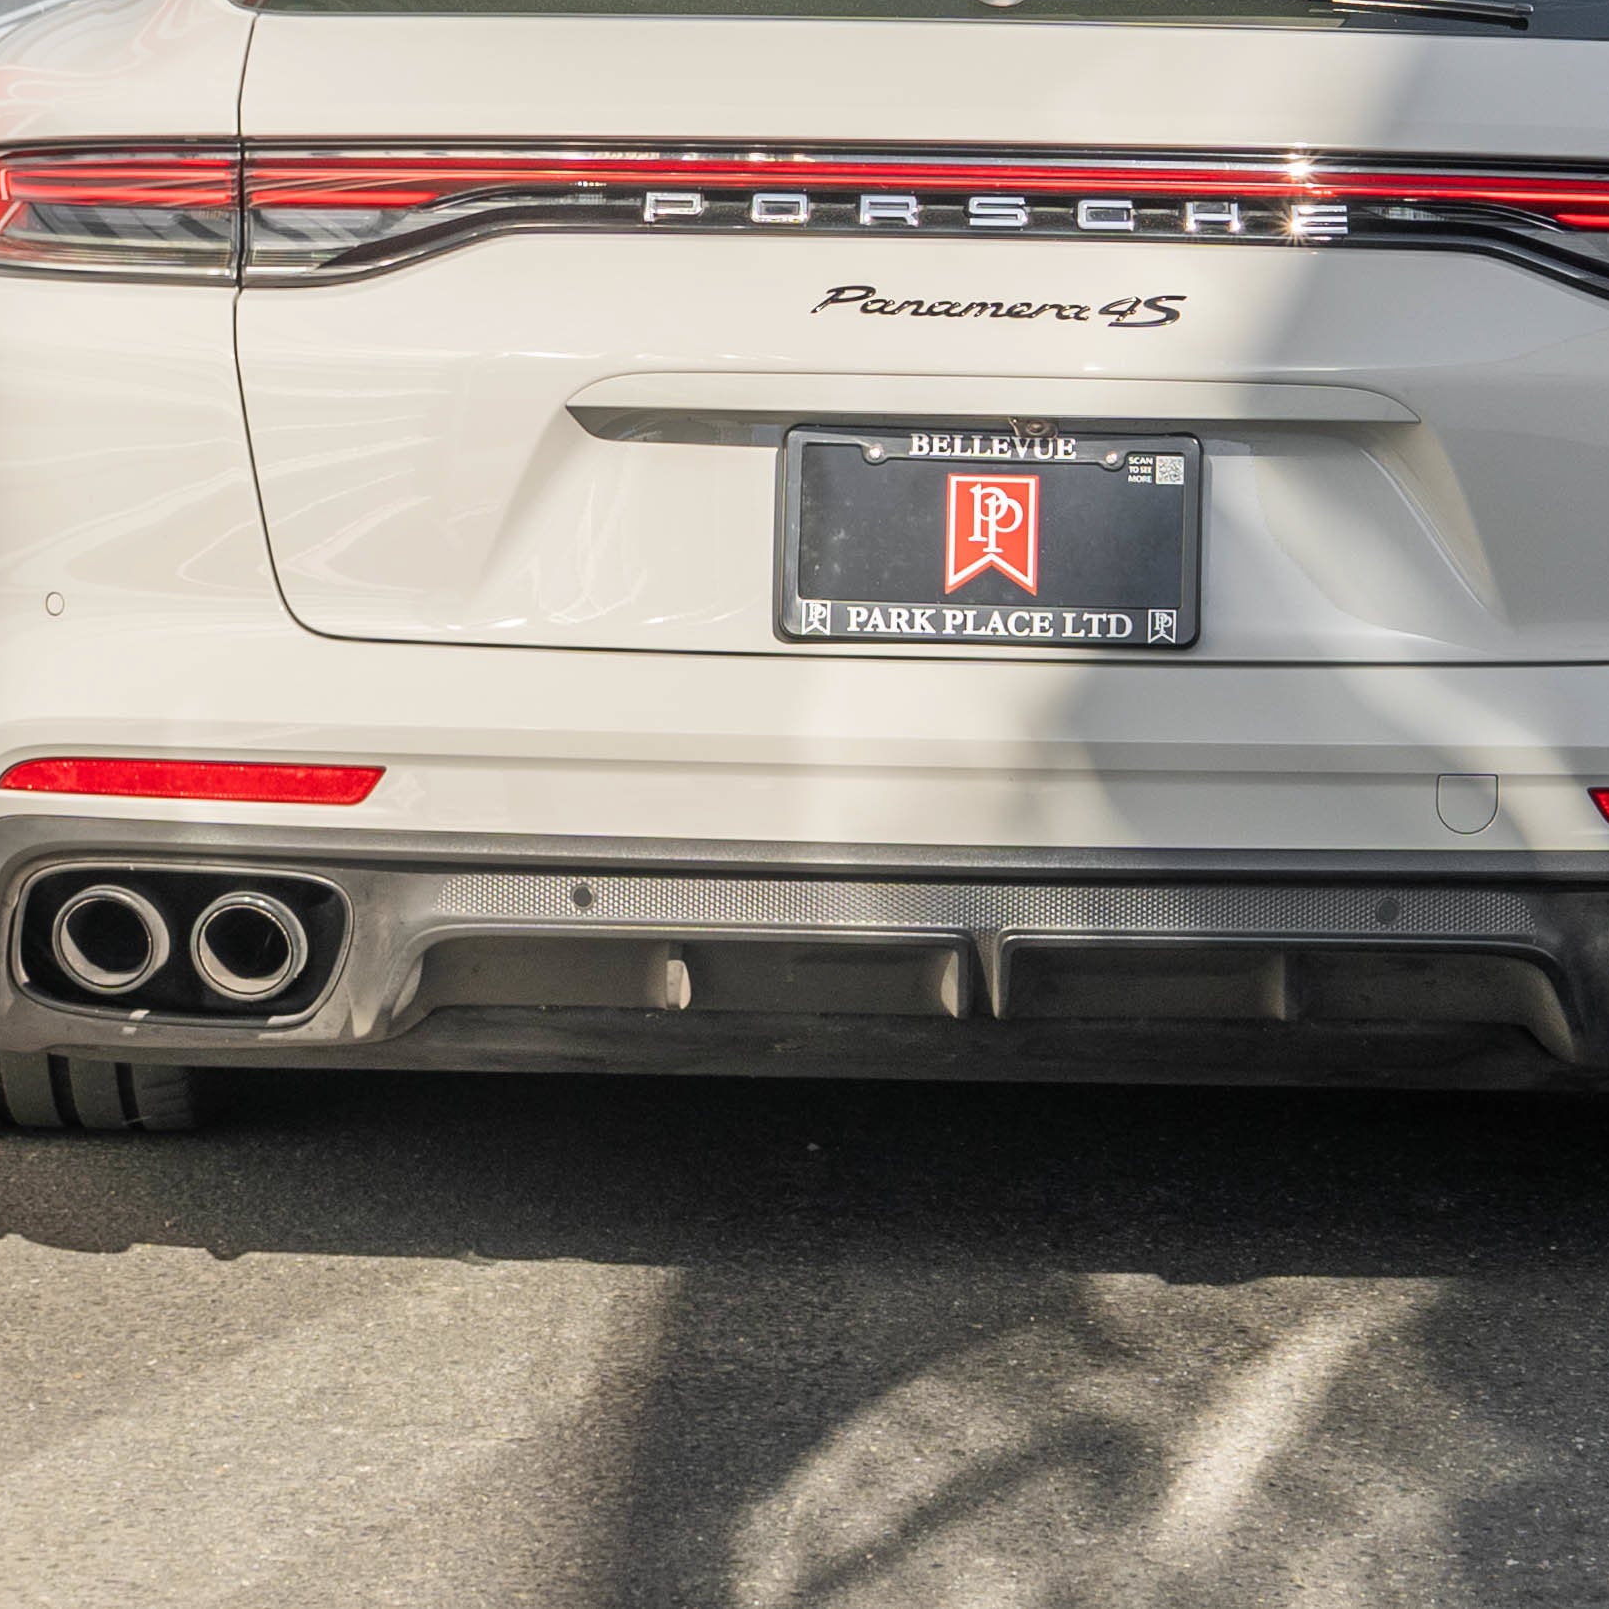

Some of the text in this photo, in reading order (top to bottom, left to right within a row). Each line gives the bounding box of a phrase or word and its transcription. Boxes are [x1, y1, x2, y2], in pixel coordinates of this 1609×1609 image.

[644, 191, 1349, 236] PORSCHE
[810, 285, 1188, 328] Panamera 4S
[909, 433, 1077, 460] BELLEVUE
[1128, 456, 1154, 465] SCAN
[1129, 466, 1139, 474] TO
[1127, 474, 1153, 484] MORE
[846, 606, 1133, 638] PARK PLACE LTD
